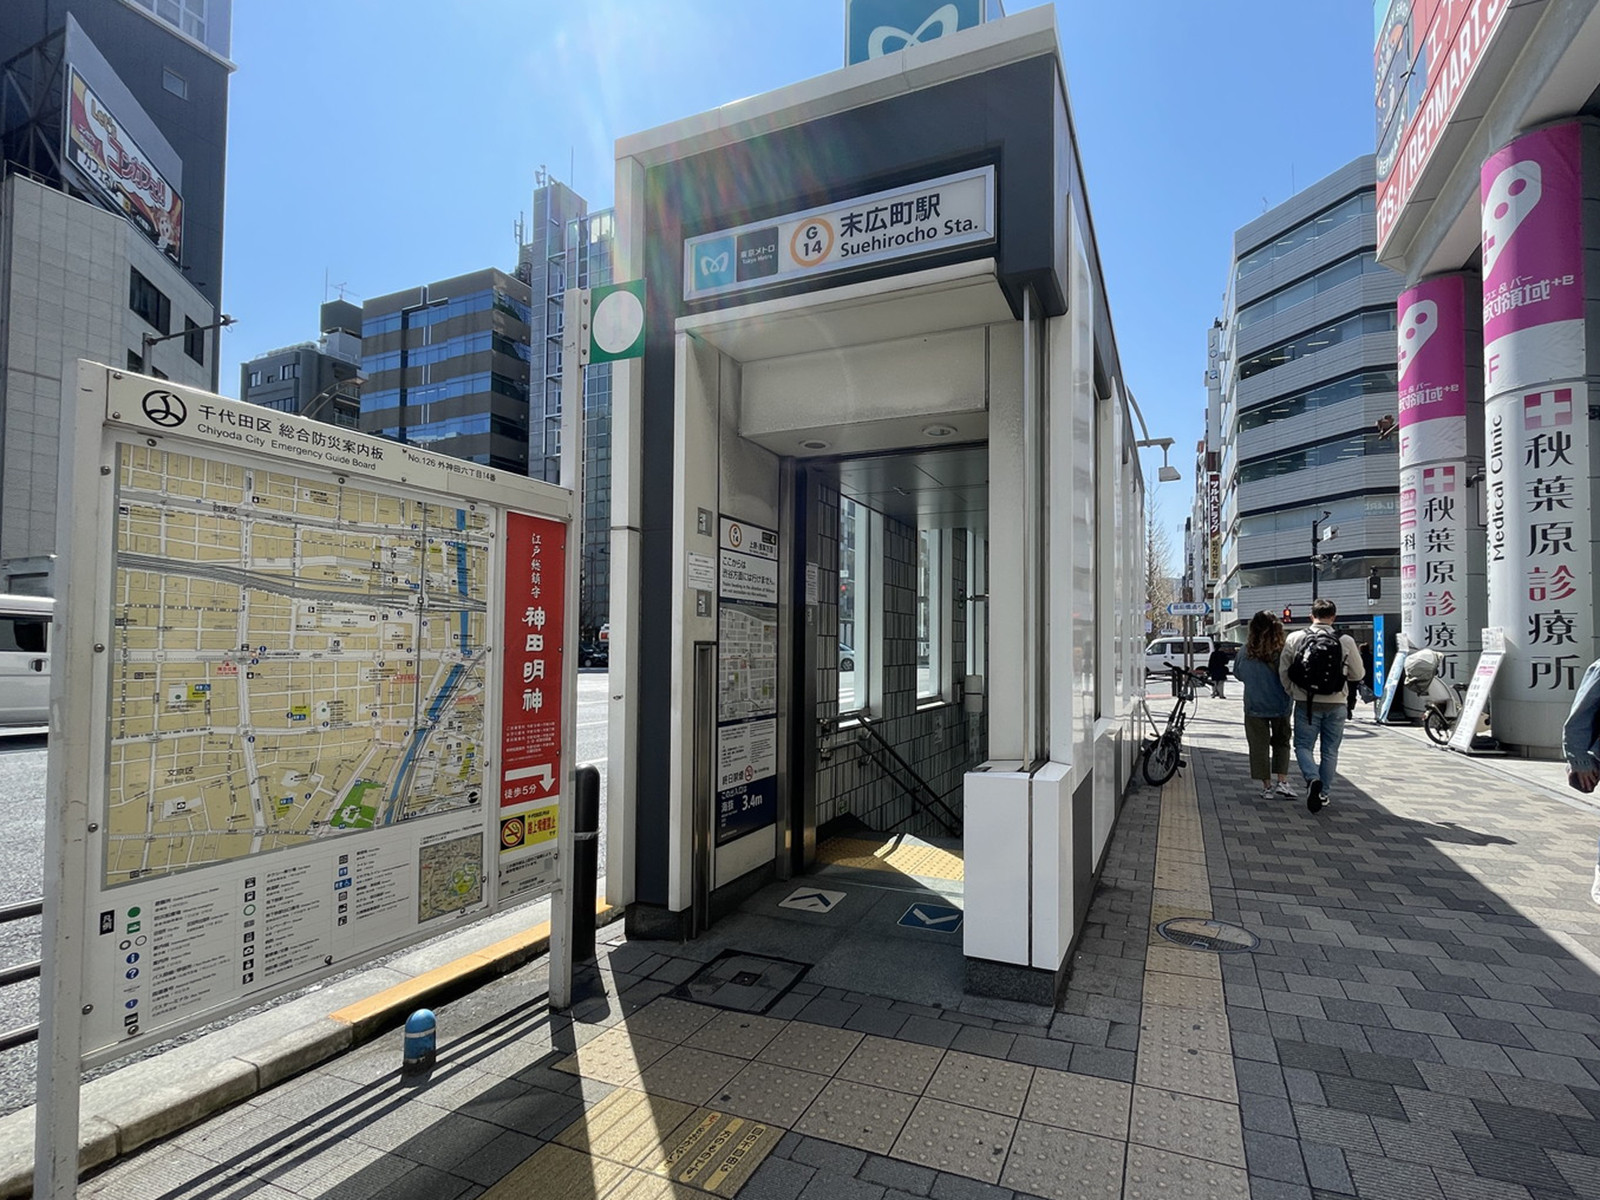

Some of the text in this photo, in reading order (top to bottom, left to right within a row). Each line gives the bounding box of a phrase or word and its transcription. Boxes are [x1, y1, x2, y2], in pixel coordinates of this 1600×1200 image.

[806, 226, 818, 239] G
[840, 193, 940, 238] 末広町駅
[740, 244, 774, 258] 東京メトロ
[803, 240, 822, 258] 14
[841, 217, 979, 257] Suehirocho Sta.
[1498, 282, 1508, 293] &
[1510, 275, 1533, 289] バー
[198, 403, 384, 460] 千代田区 総合防災案内板
[198, 423, 376, 471] Chiyoda City Emergency Guide Board
[408, 452, 497, 483] No.126 外神田六丁目14番
[1210, 480, 1220, 533] ツルハドラッグ
[1490, 414, 1505, 562] Medical Clinic
[530, 532, 542, 600] 江戸総鎮守
[723, 556, 746, 570] ここからは
[1525, 431, 1581, 691] 秋葉原診療所
[522, 606, 547, 713] 神田明神
[504, 784, 537, 800] 徒歩5分
[742, 794, 763, 811] 3.4m
